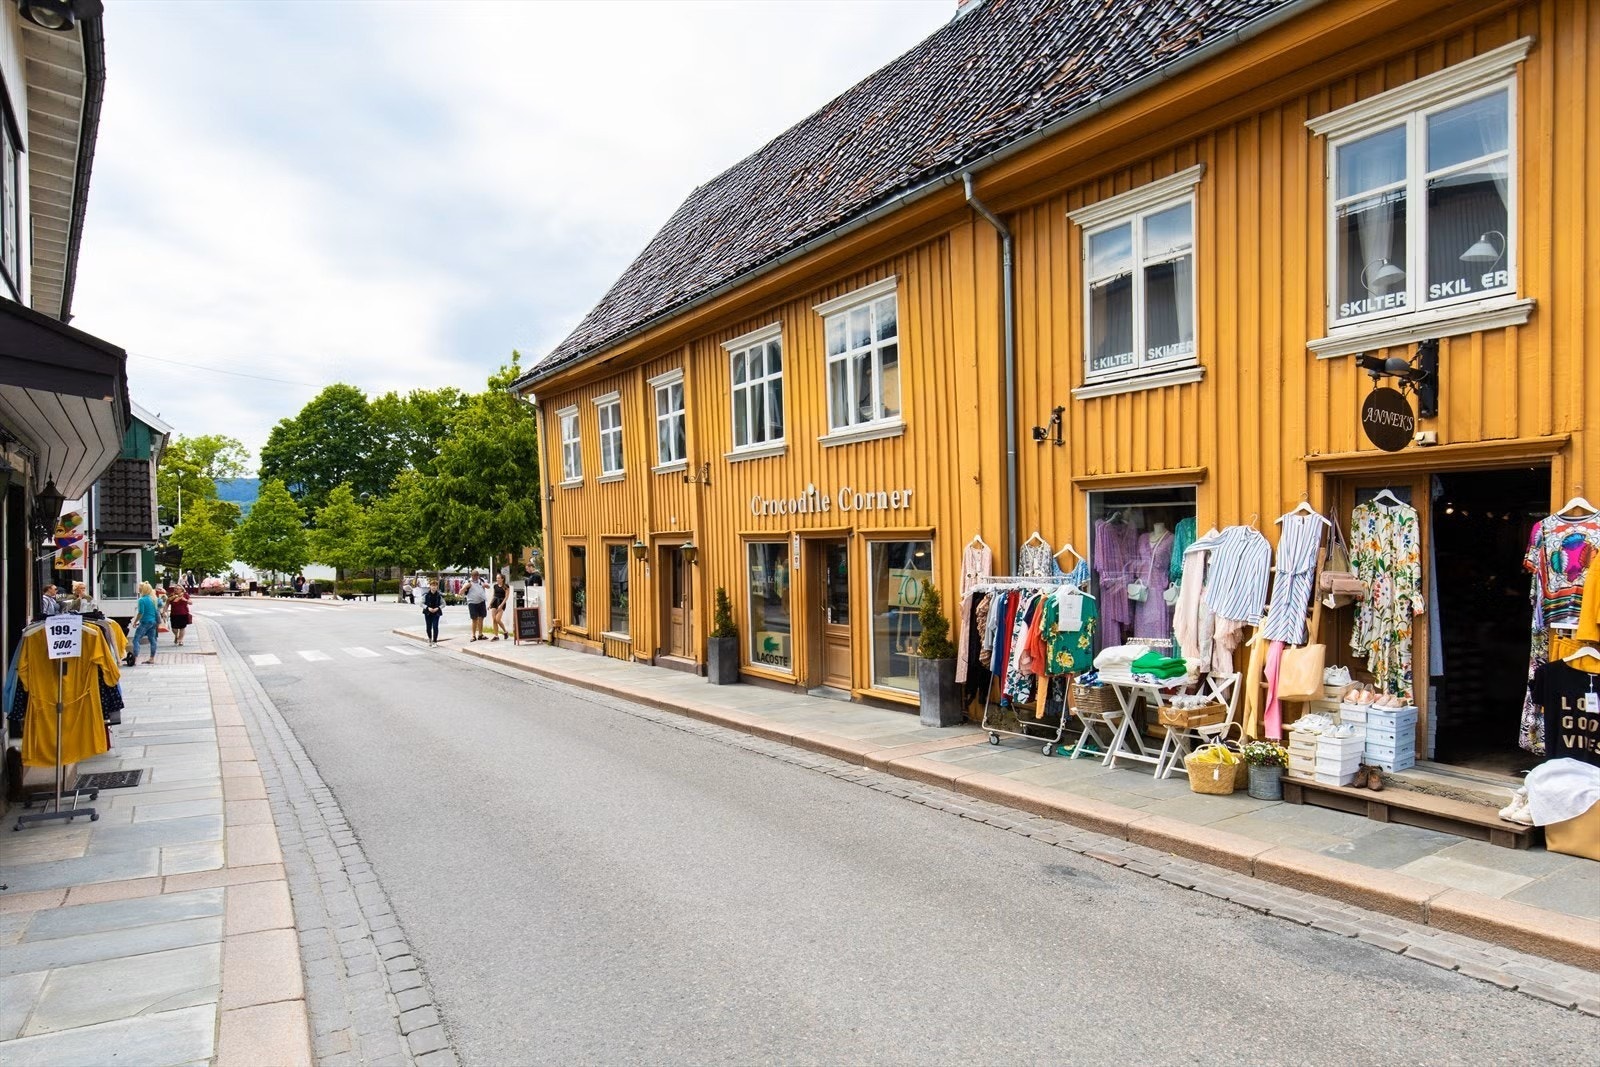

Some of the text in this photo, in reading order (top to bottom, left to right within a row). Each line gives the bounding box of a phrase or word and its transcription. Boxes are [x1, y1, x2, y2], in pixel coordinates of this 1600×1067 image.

[1340, 291, 1407, 317] SKILTER
[751, 482, 912, 516] Crocodile Corner
[892, 574, 923, 606] 70
[50, 625, 77, 636] 199,-
[53, 640, 77, 650] 500,-
[756, 651, 788, 667] LACOSTE
[1561, 696, 1586, 711] LO
[1562, 735, 1600, 754] VIES
